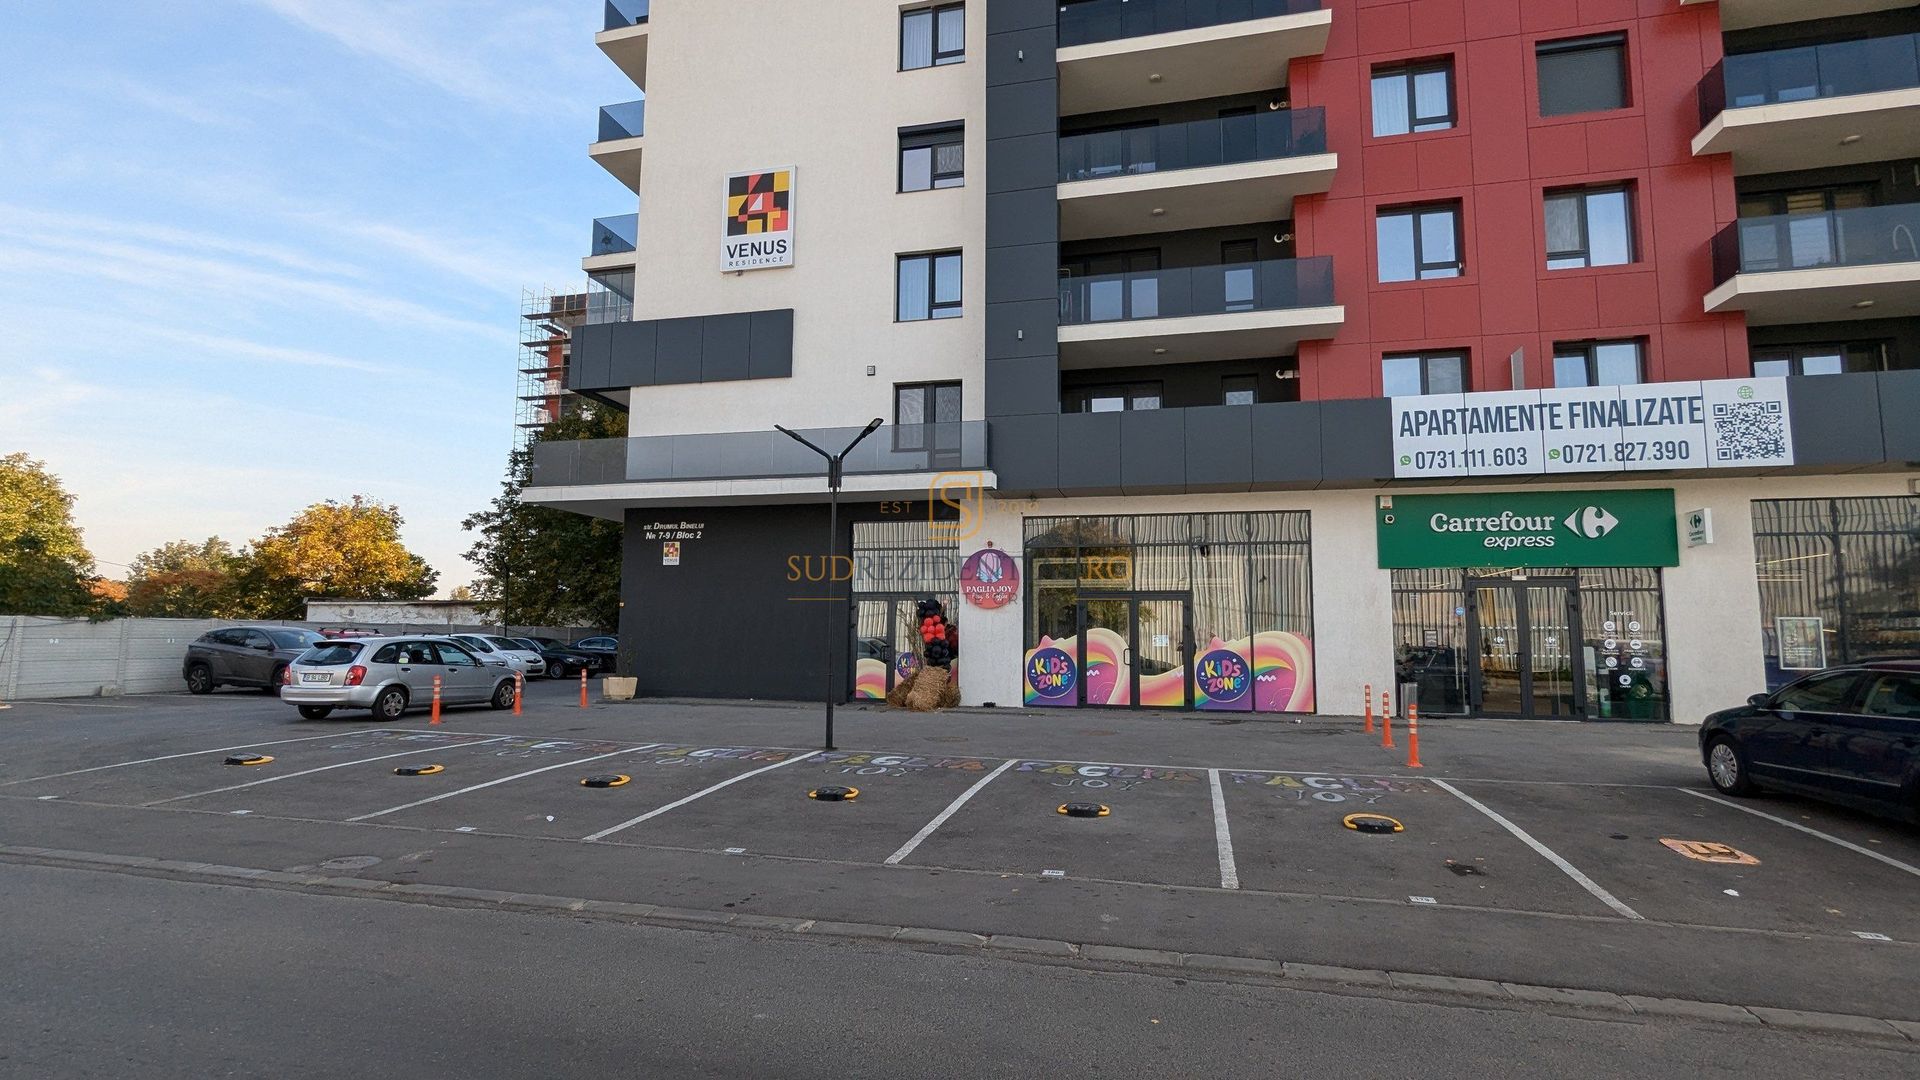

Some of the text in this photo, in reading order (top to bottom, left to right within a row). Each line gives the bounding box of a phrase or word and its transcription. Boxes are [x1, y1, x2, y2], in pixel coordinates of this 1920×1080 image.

[727, 239, 787, 258] VENUS
[728, 256, 784, 267] RESIDENCE
[1400, 396, 1704, 437] APARTAMENTE FINALIZATE
[1415, 447, 1528, 470] 0731.111.603
[1562, 440, 1690, 464] 0721.827.390
[1430, 510, 1555, 532] Carrefour
[658, 531, 671, 539] 7-9
[676, 531, 695, 539] Bloc
[696, 531, 702, 539] 2
[1483, 535, 1555, 550] express
[966, 585, 1013, 593] PAGLIA JOY
